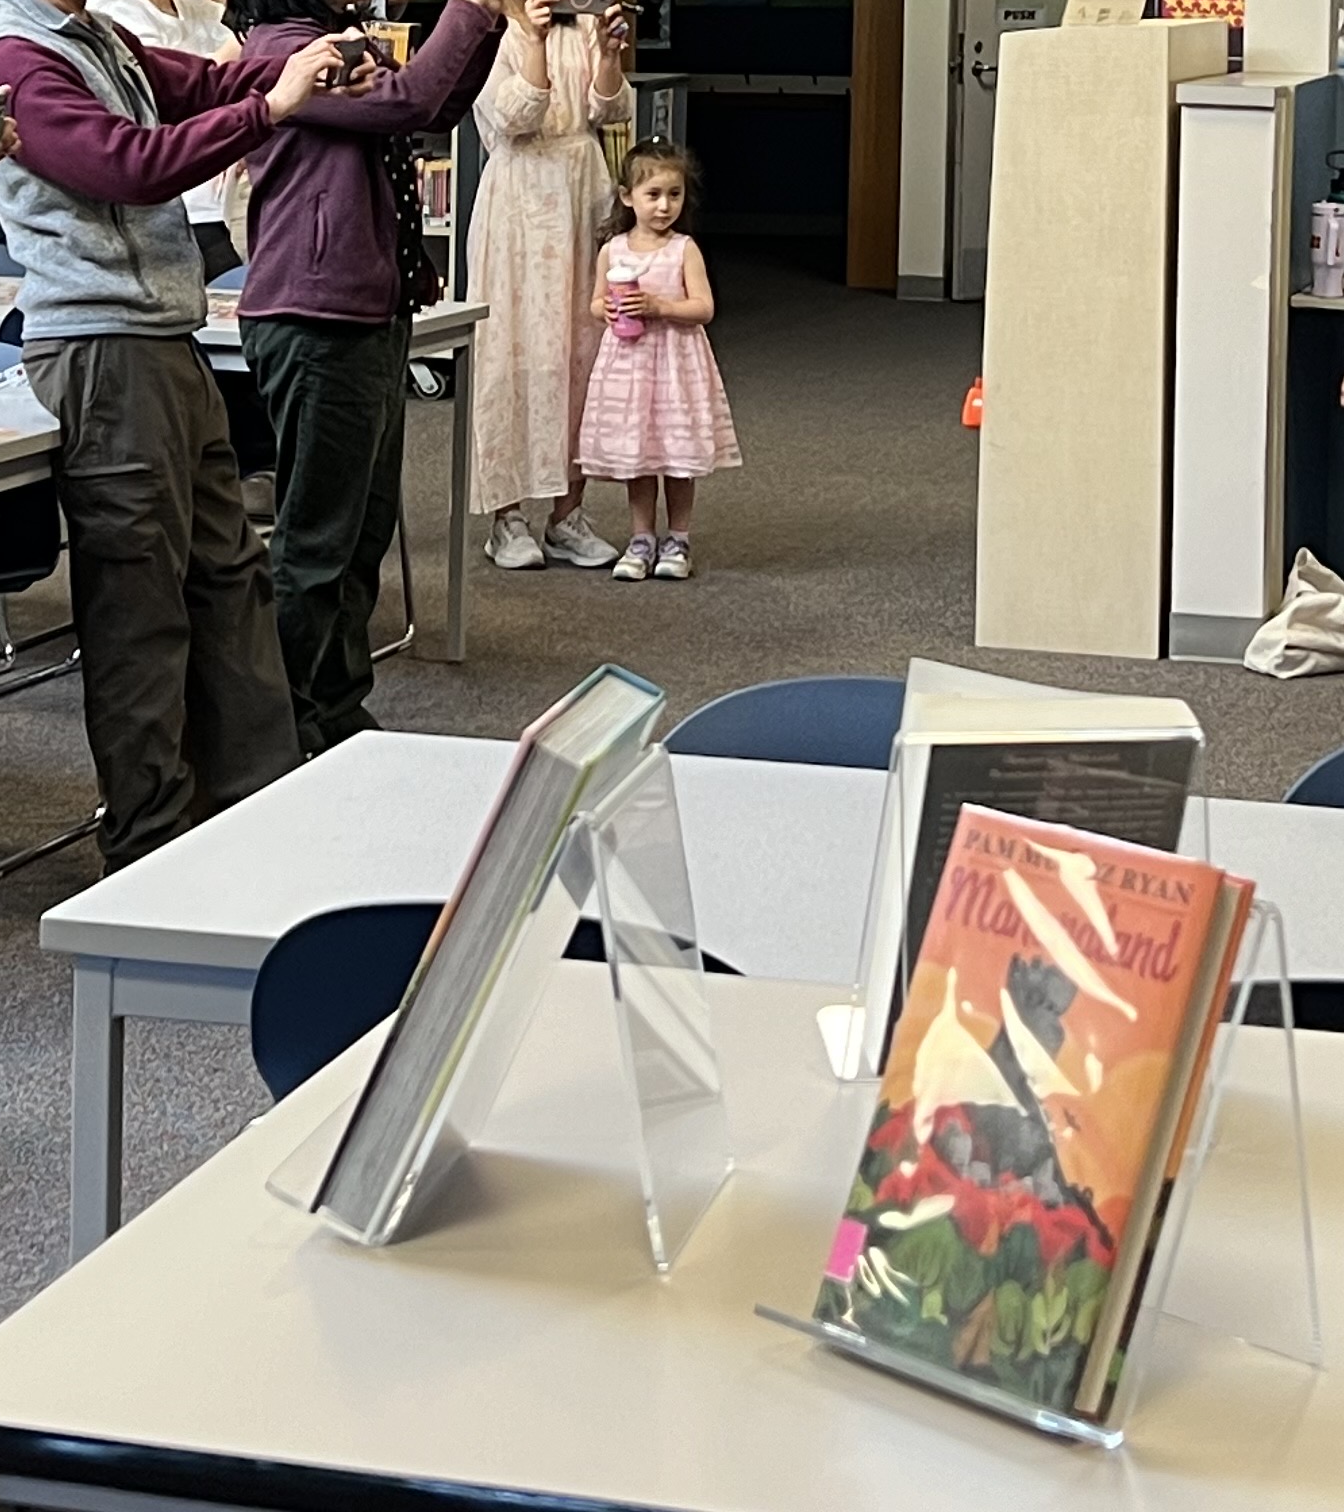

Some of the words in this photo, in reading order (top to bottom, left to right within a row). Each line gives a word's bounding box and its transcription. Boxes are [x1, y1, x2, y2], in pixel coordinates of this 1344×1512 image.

[1003, 10, 1036, 21] PUSH
[963, 829, 1016, 864] PAM
[1119, 868, 1197, 906] RYAN
